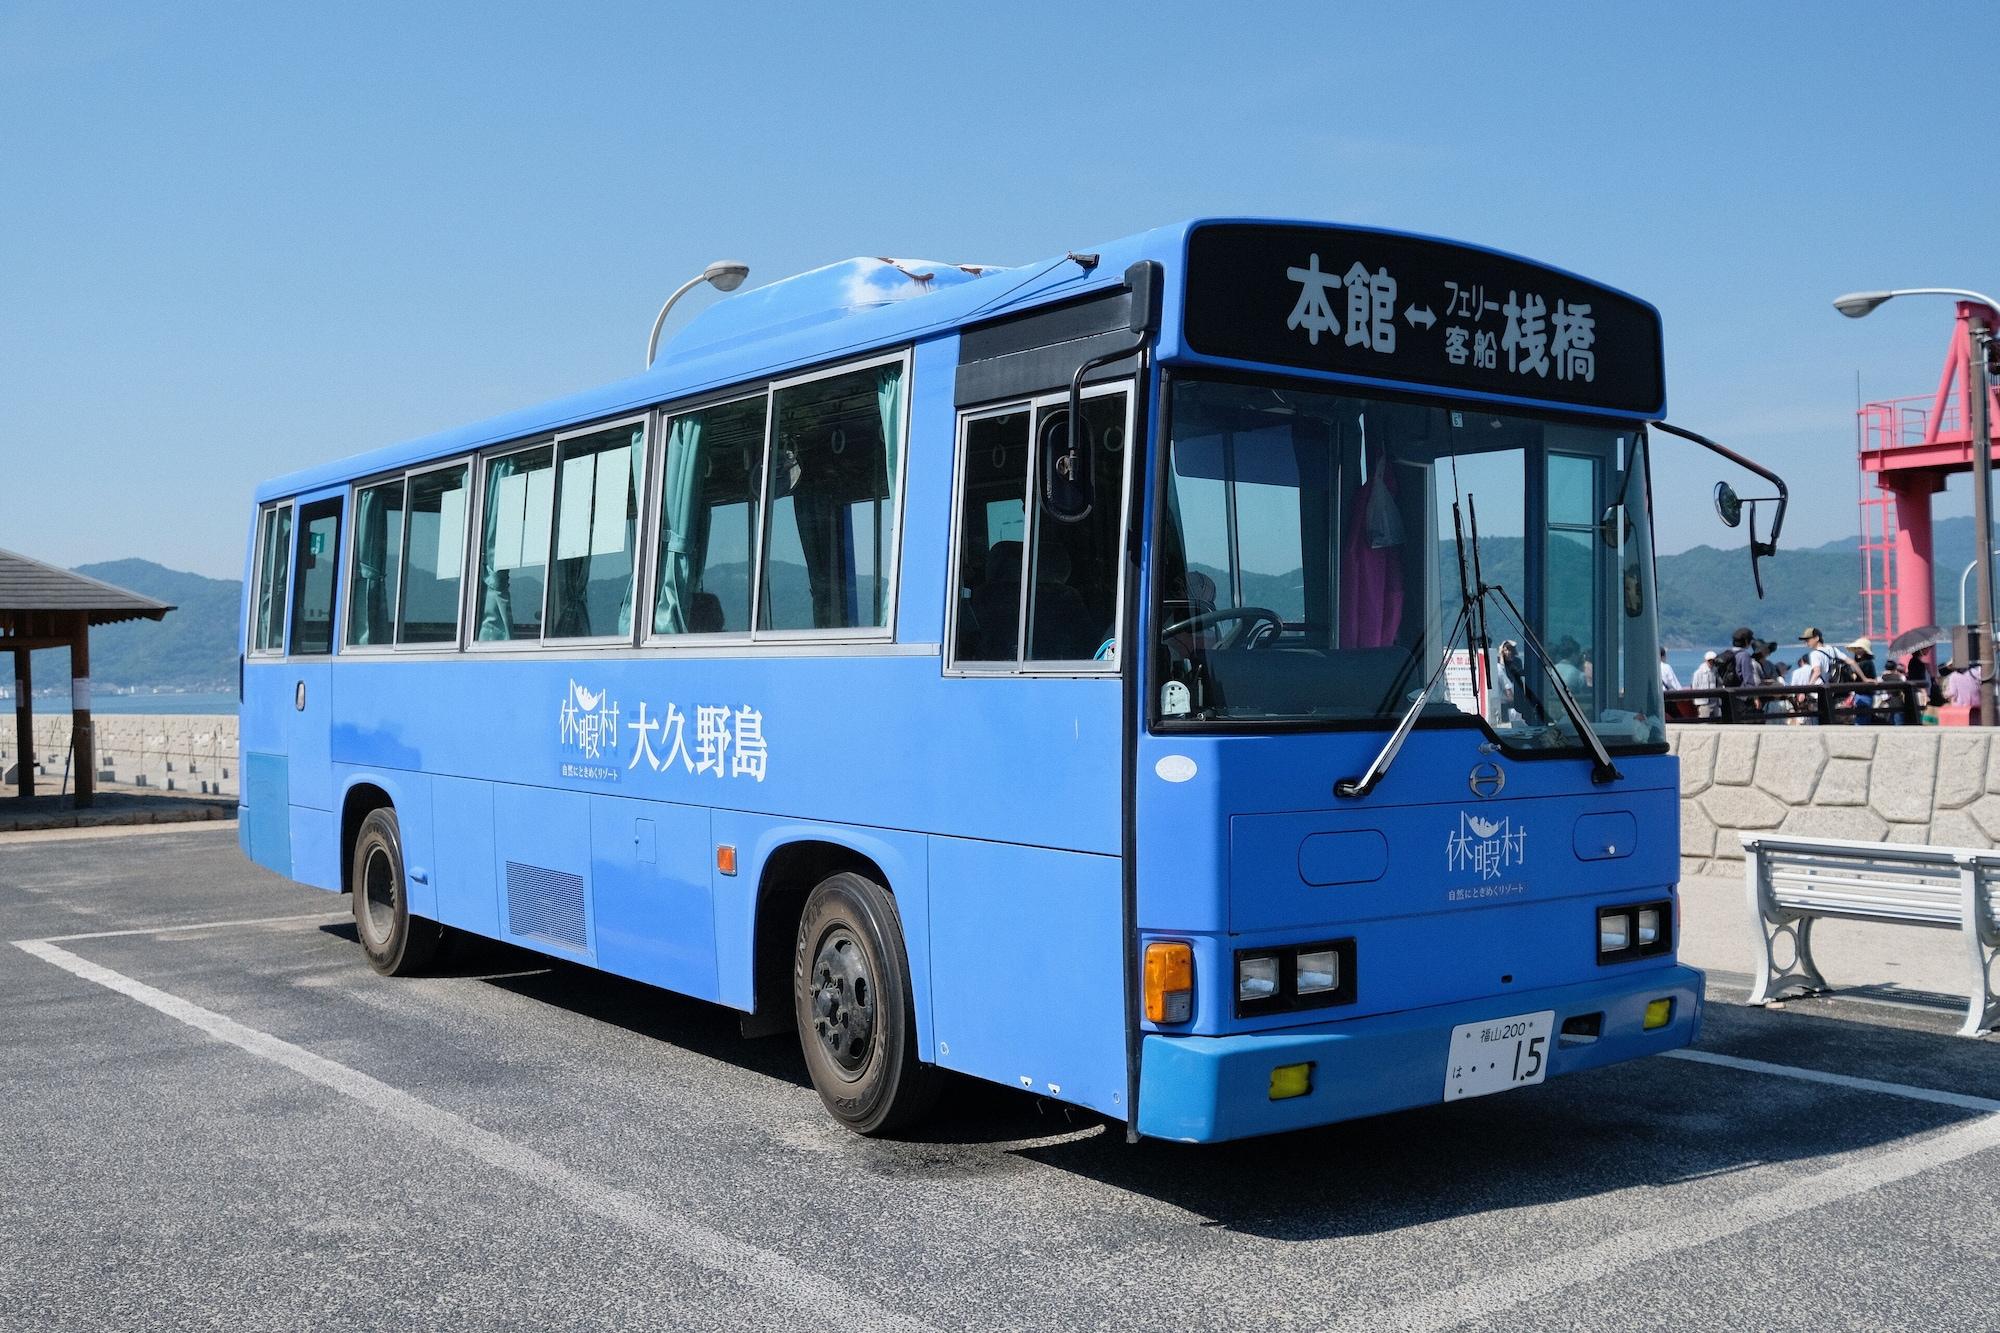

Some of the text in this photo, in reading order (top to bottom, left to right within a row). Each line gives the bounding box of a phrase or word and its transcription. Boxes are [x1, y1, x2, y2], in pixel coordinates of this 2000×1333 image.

[1286, 252, 1398, 354] 本館
[1444, 281, 1500, 323] フェリー
[1444, 326, 1498, 371] 客船
[559, 678, 620, 760] 休暇村
[627, 700, 768, 783] 大久野島
[1445, 810, 1527, 881] 休暇村
[1448, 883, 1524, 901] 自然にときめくリゾート
